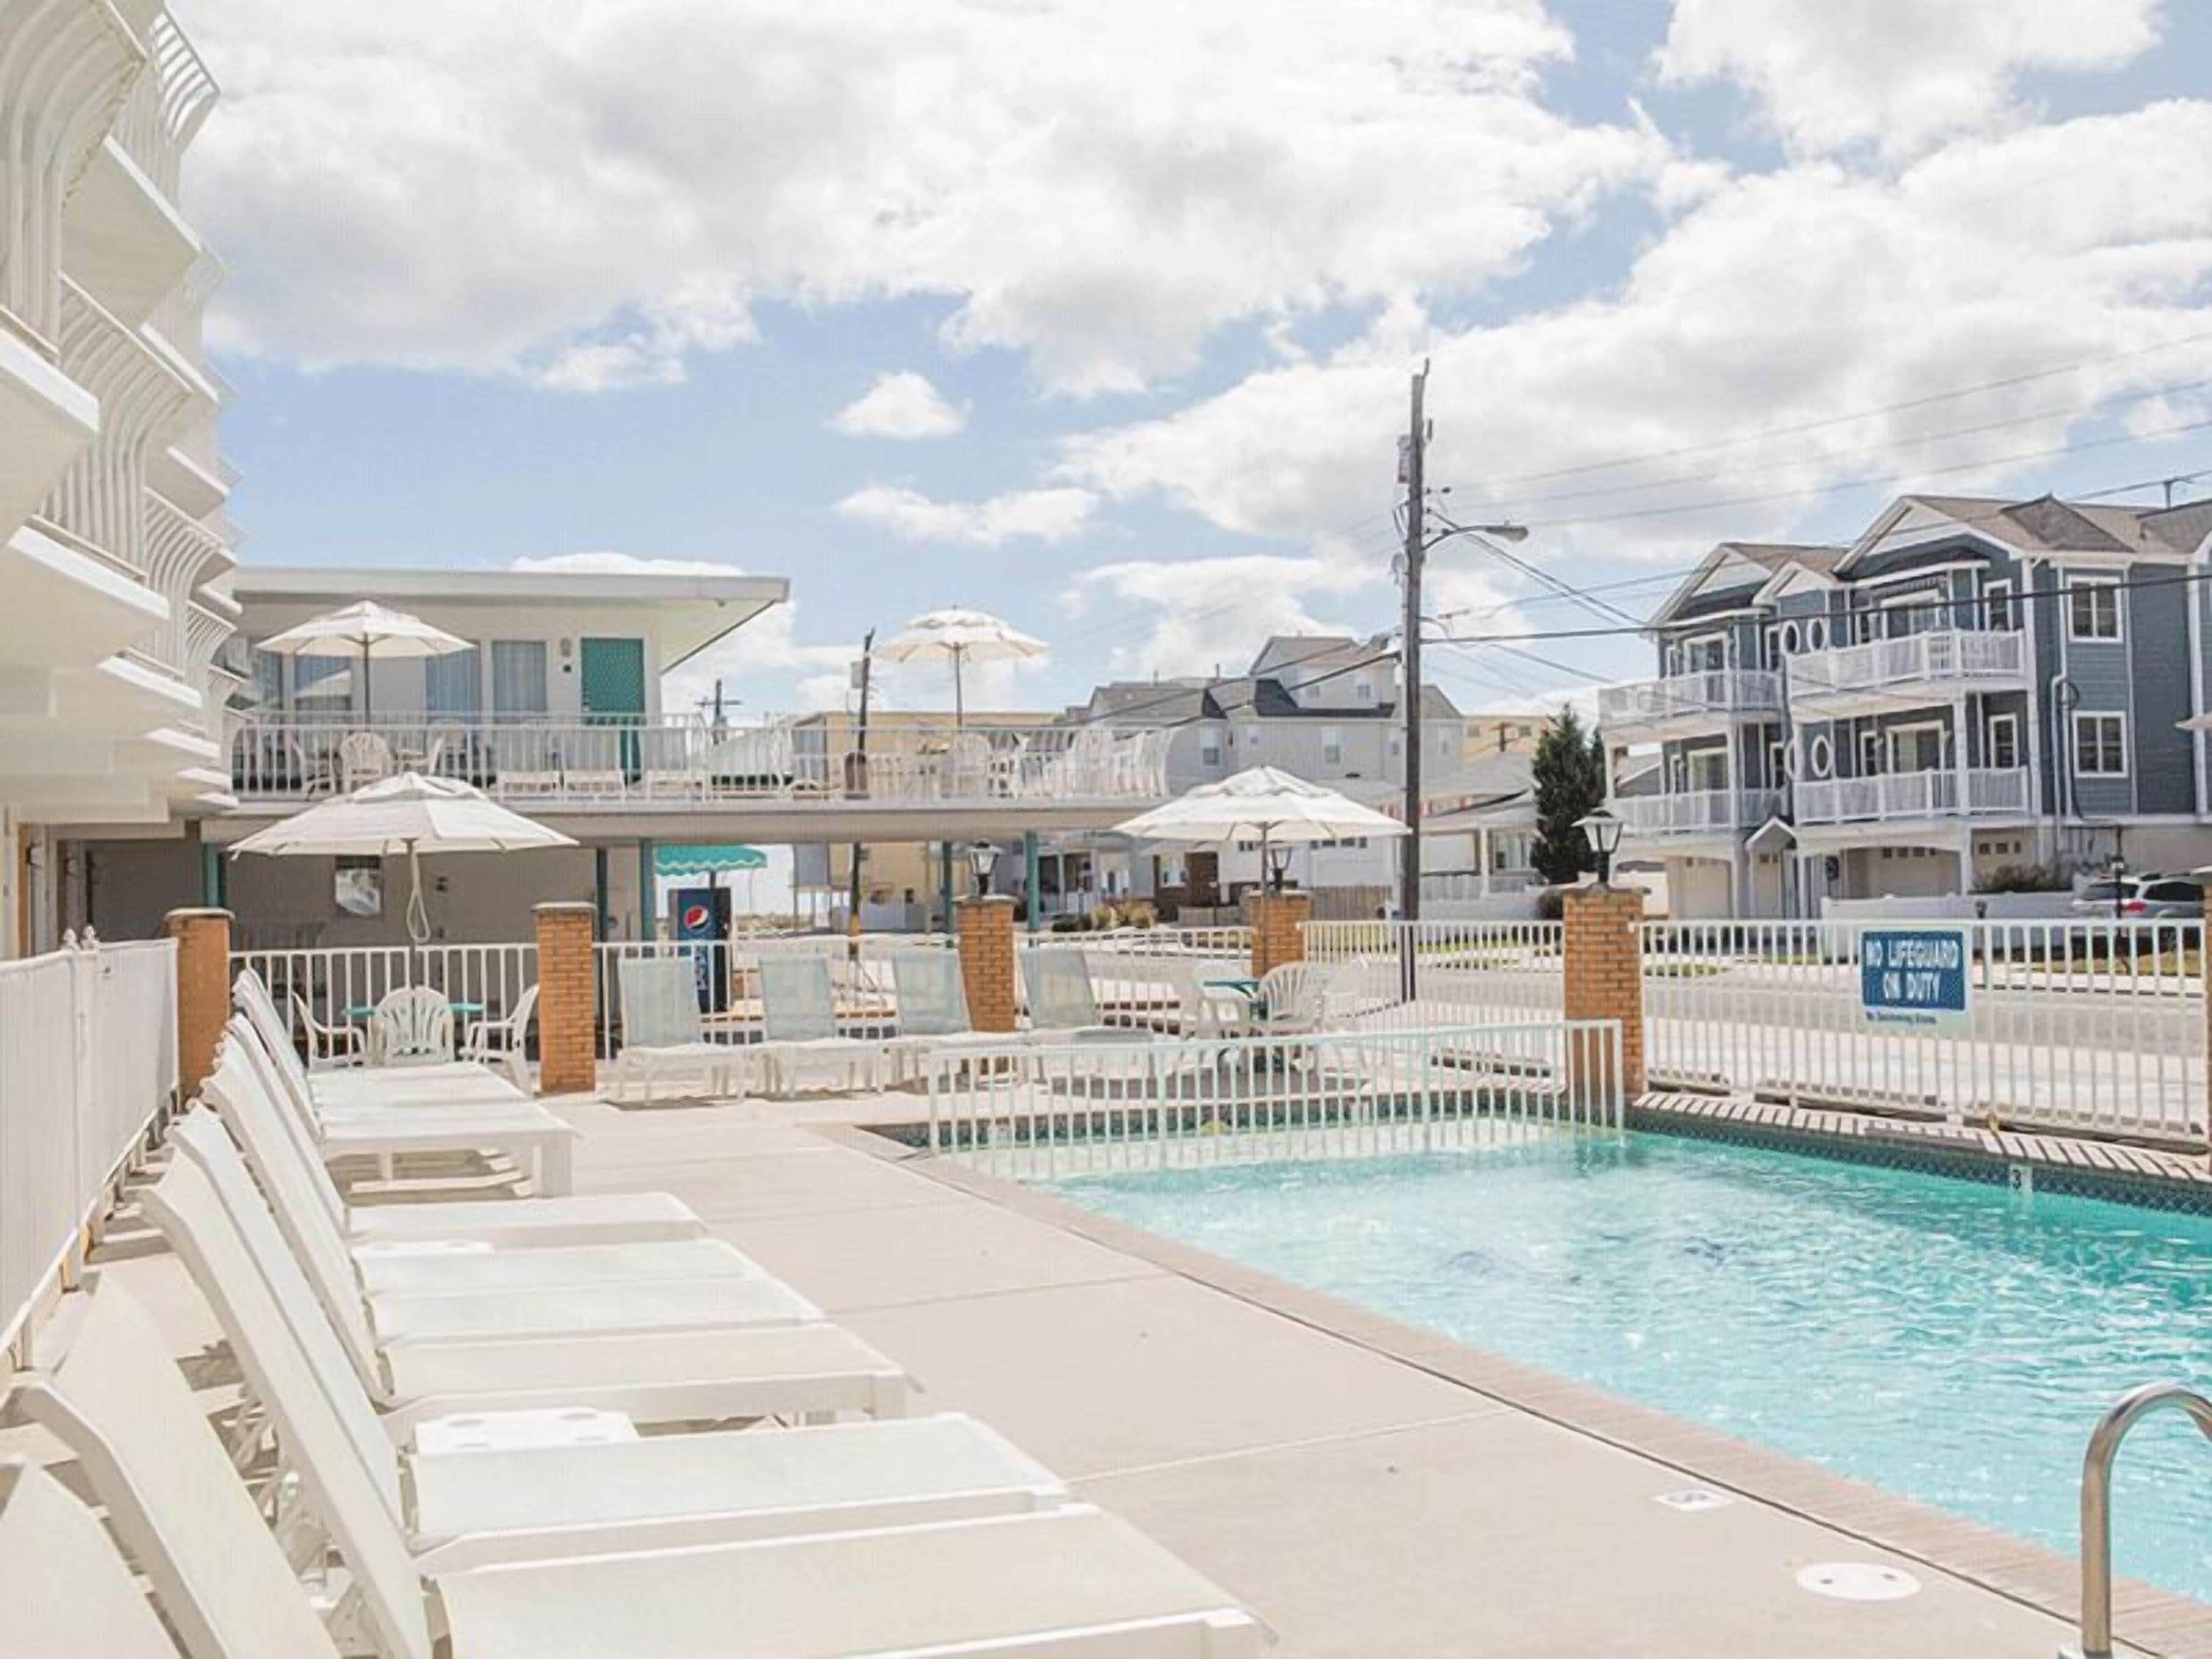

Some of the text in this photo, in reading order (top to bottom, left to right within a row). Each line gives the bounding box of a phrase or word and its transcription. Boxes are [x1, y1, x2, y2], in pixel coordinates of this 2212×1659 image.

[1866, 940, 1959, 968] NO LIFEGUARD
[1883, 971, 1941, 1002] ON DUTY
